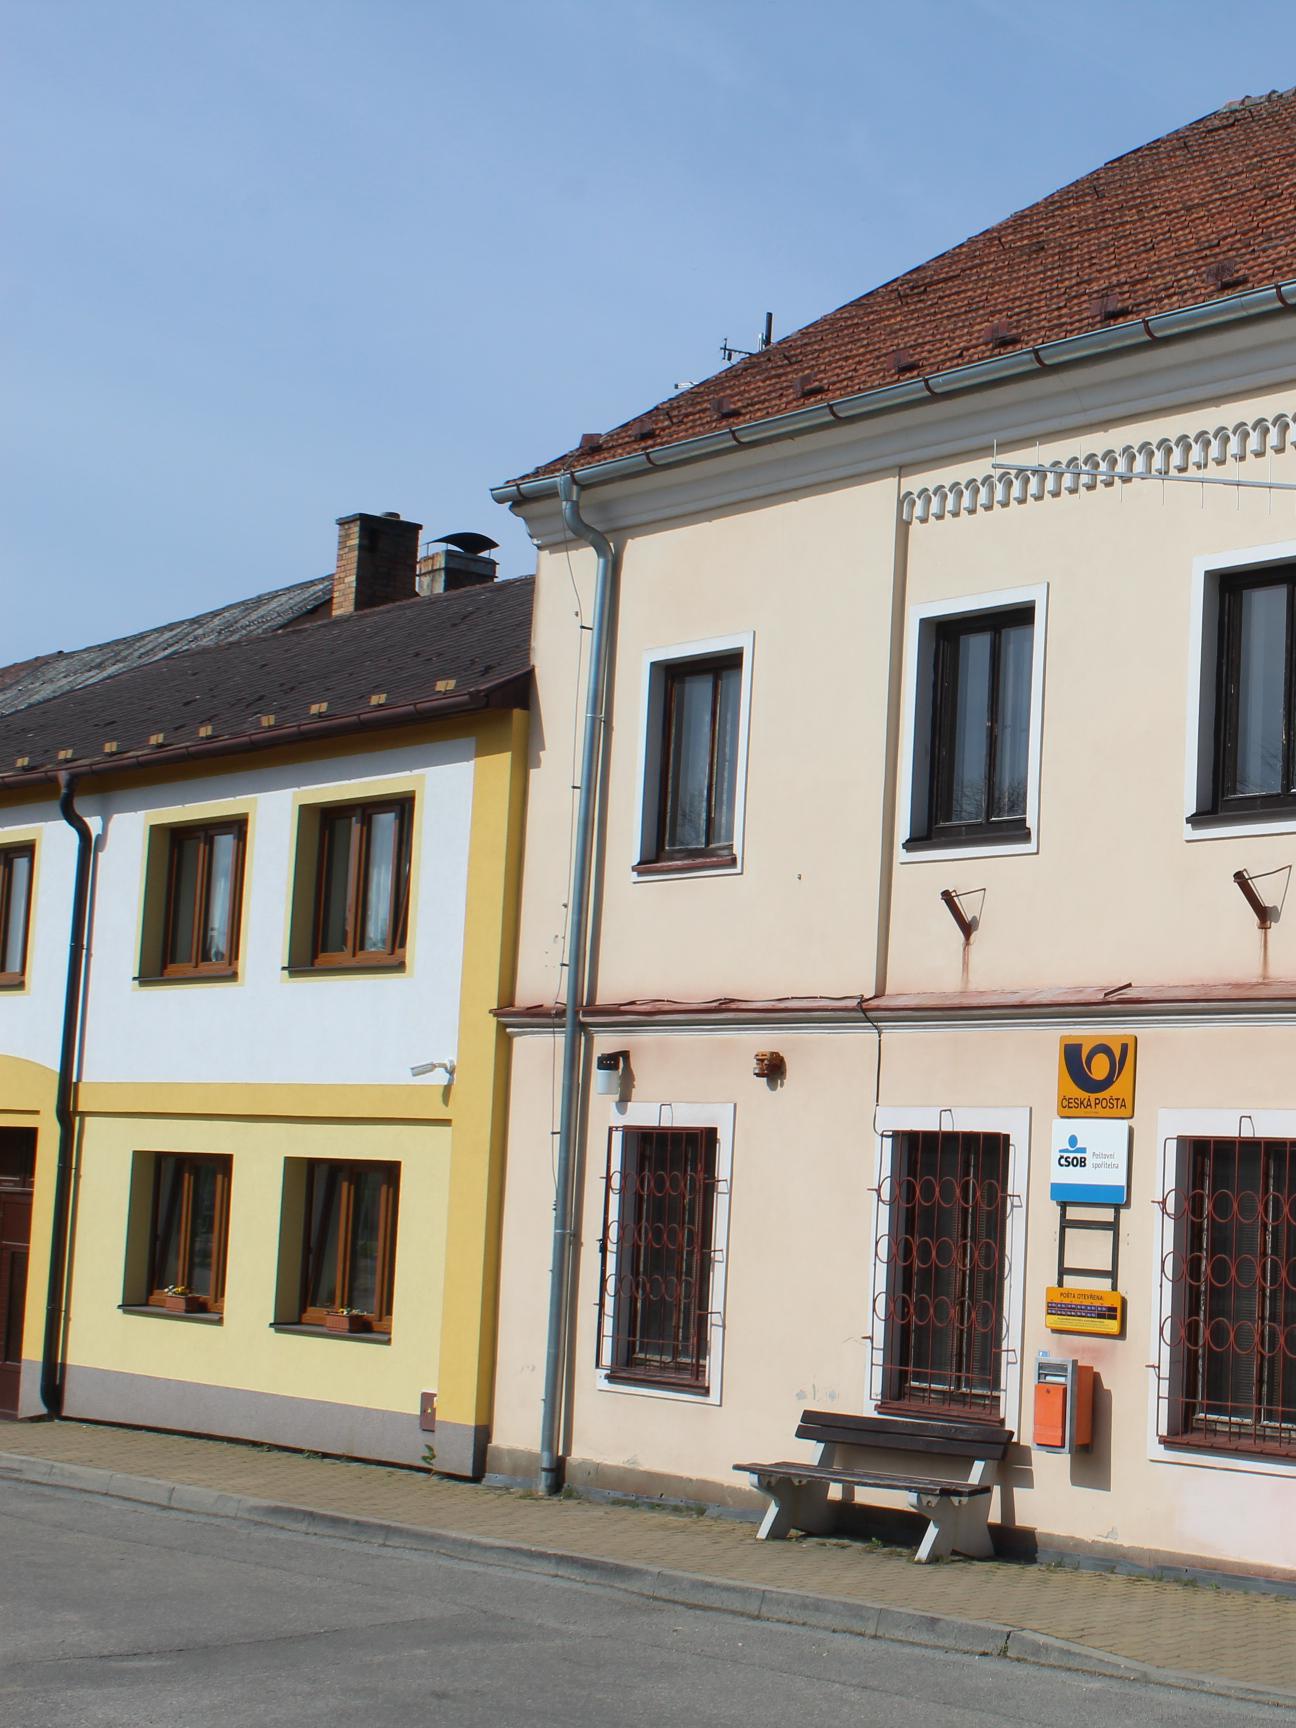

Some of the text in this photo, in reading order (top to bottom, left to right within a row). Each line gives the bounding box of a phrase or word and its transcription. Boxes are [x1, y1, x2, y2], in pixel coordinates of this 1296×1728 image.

[1061, 1096, 1126, 1109] ČESKÁ POŠTA
[1057, 1155, 1087, 1168] ČSOB
[1092, 1161, 1119, 1170] spořitelna
